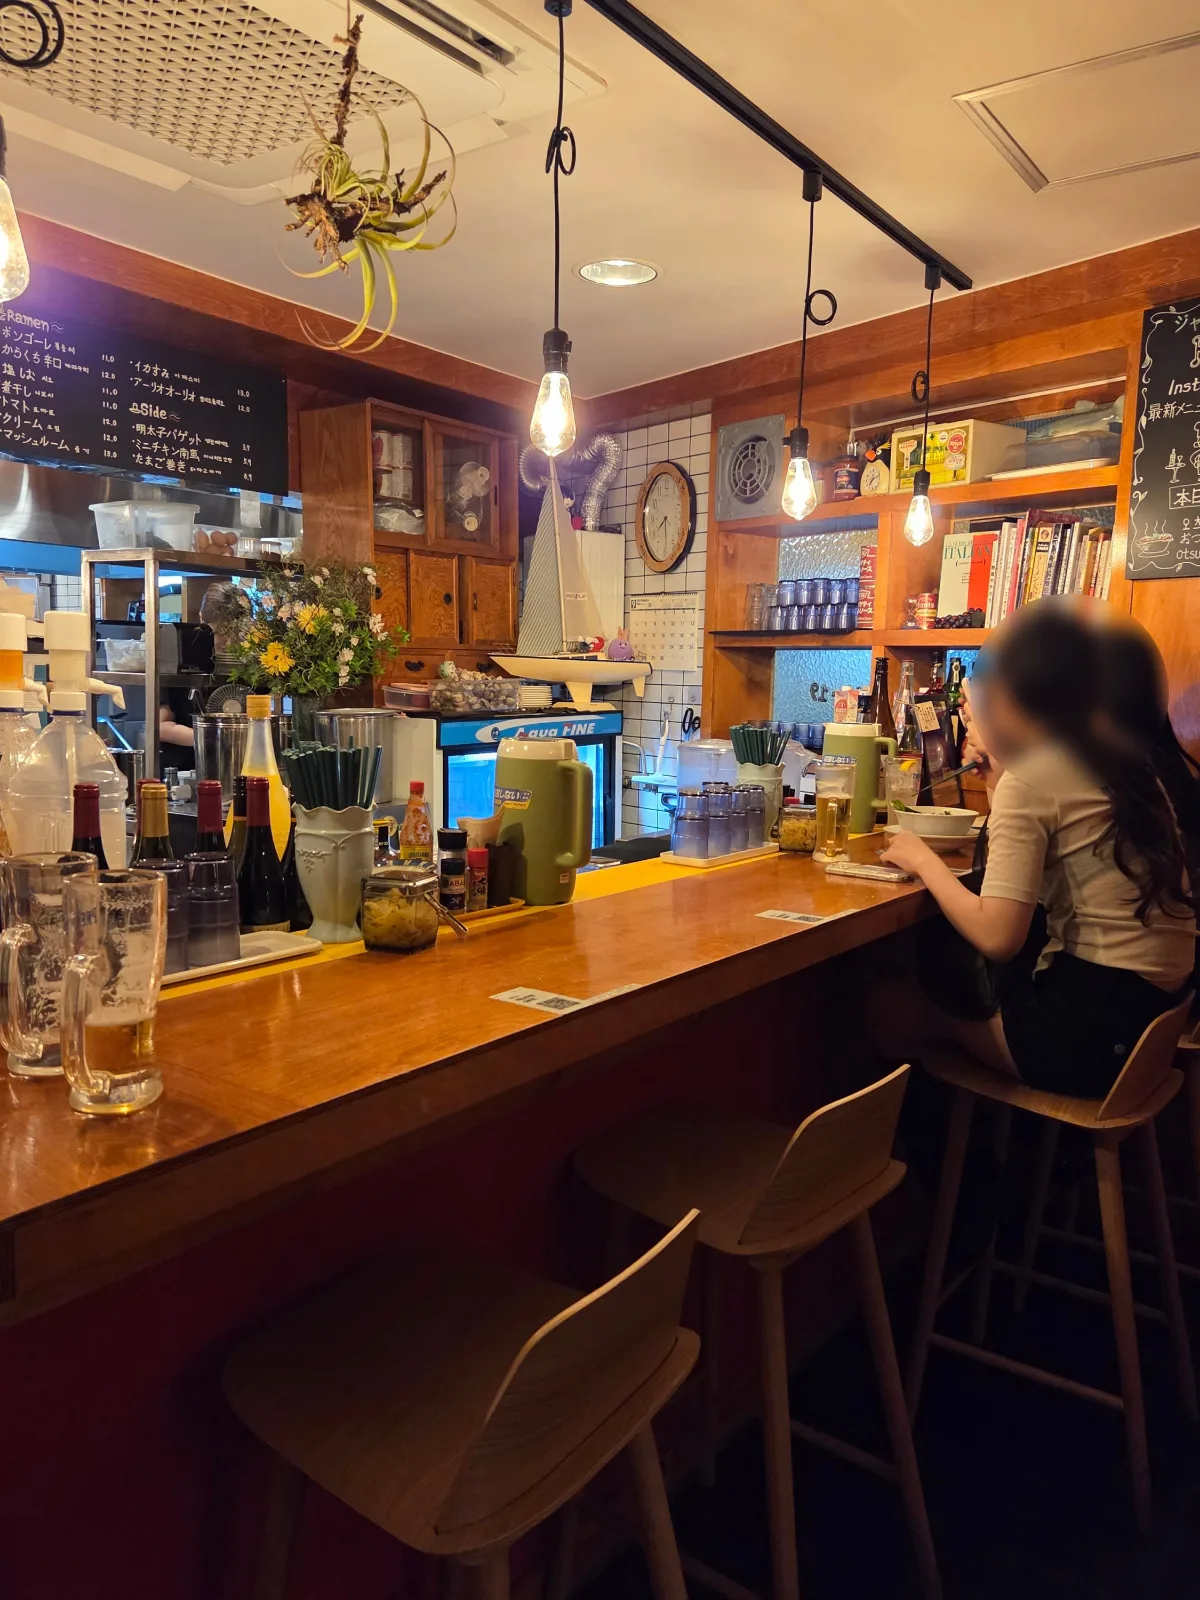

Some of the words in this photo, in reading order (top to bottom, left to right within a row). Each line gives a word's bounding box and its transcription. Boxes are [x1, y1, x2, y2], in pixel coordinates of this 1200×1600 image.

[7, 309, 50, 333] Ramen
[2, 326, 52, 350] ボンゴーレ
[101, 354, 115, 363] 11.0
[1, 343, 41, 364] からくち
[43, 354, 62, 370] 辛口
[101, 371, 116, 380] 12.0
[134, 360, 170, 379] イカすみ
[2, 362, 16, 377] 塩
[19, 367, 36, 382] しお
[102, 387, 118, 396] 11.0
[1, 380, 32, 398] 煮干し
[102, 401, 118, 410] 11.0
[133, 377, 196, 402] アーリオオーリオ
[237, 404, 251, 413] 12.0
[2, 395, 30, 413] トマト
[102, 418, 117, 427] 12.0
[140, 402, 168, 420] Side
[2, 412, 43, 431] クリーム
[102, 433, 118, 442] 12.0
[3, 429, 70, 452] マッシュルーム
[103, 449, 118, 458] 13.0
[135, 452, 187, 473] たまご巻き
[562, 722, 596, 736] FINE
